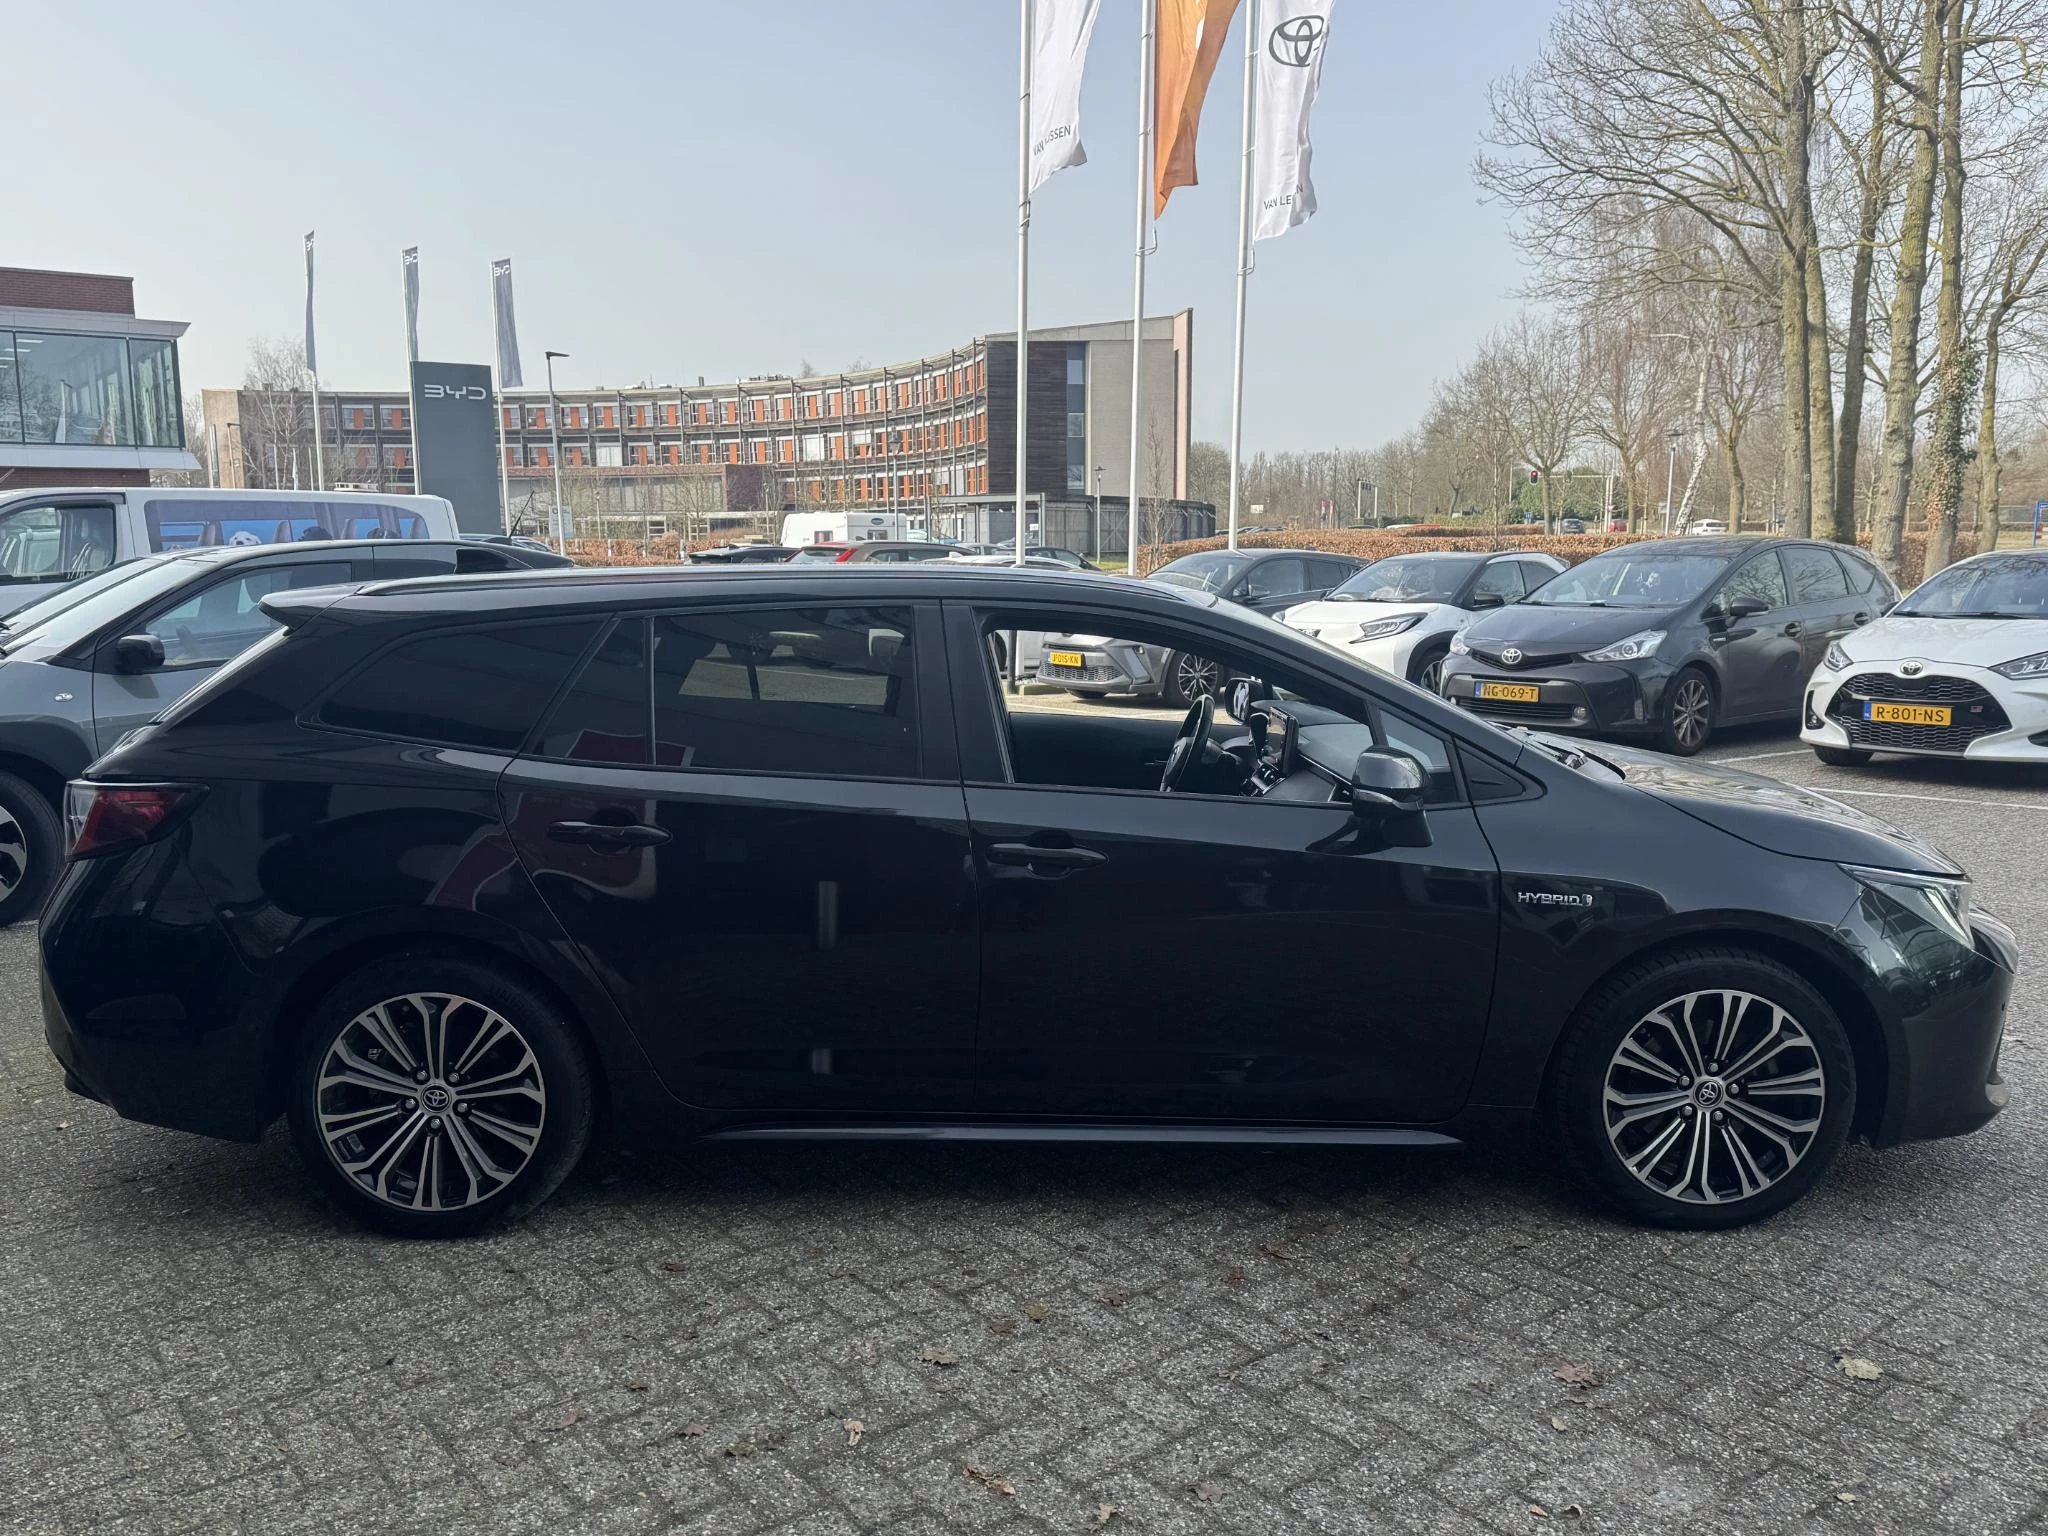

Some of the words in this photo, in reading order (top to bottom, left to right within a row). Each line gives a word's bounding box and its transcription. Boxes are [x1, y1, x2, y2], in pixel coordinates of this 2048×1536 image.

[1263, 197, 1278, 210] VAN
[493, 264, 510, 277] BYD
[424, 384, 487, 400] BYD
[1482, 685, 1537, 700] NG-069-T
[1876, 706, 1945, 723] R-801-NS
[1517, 892, 1583, 906] HYBRID
